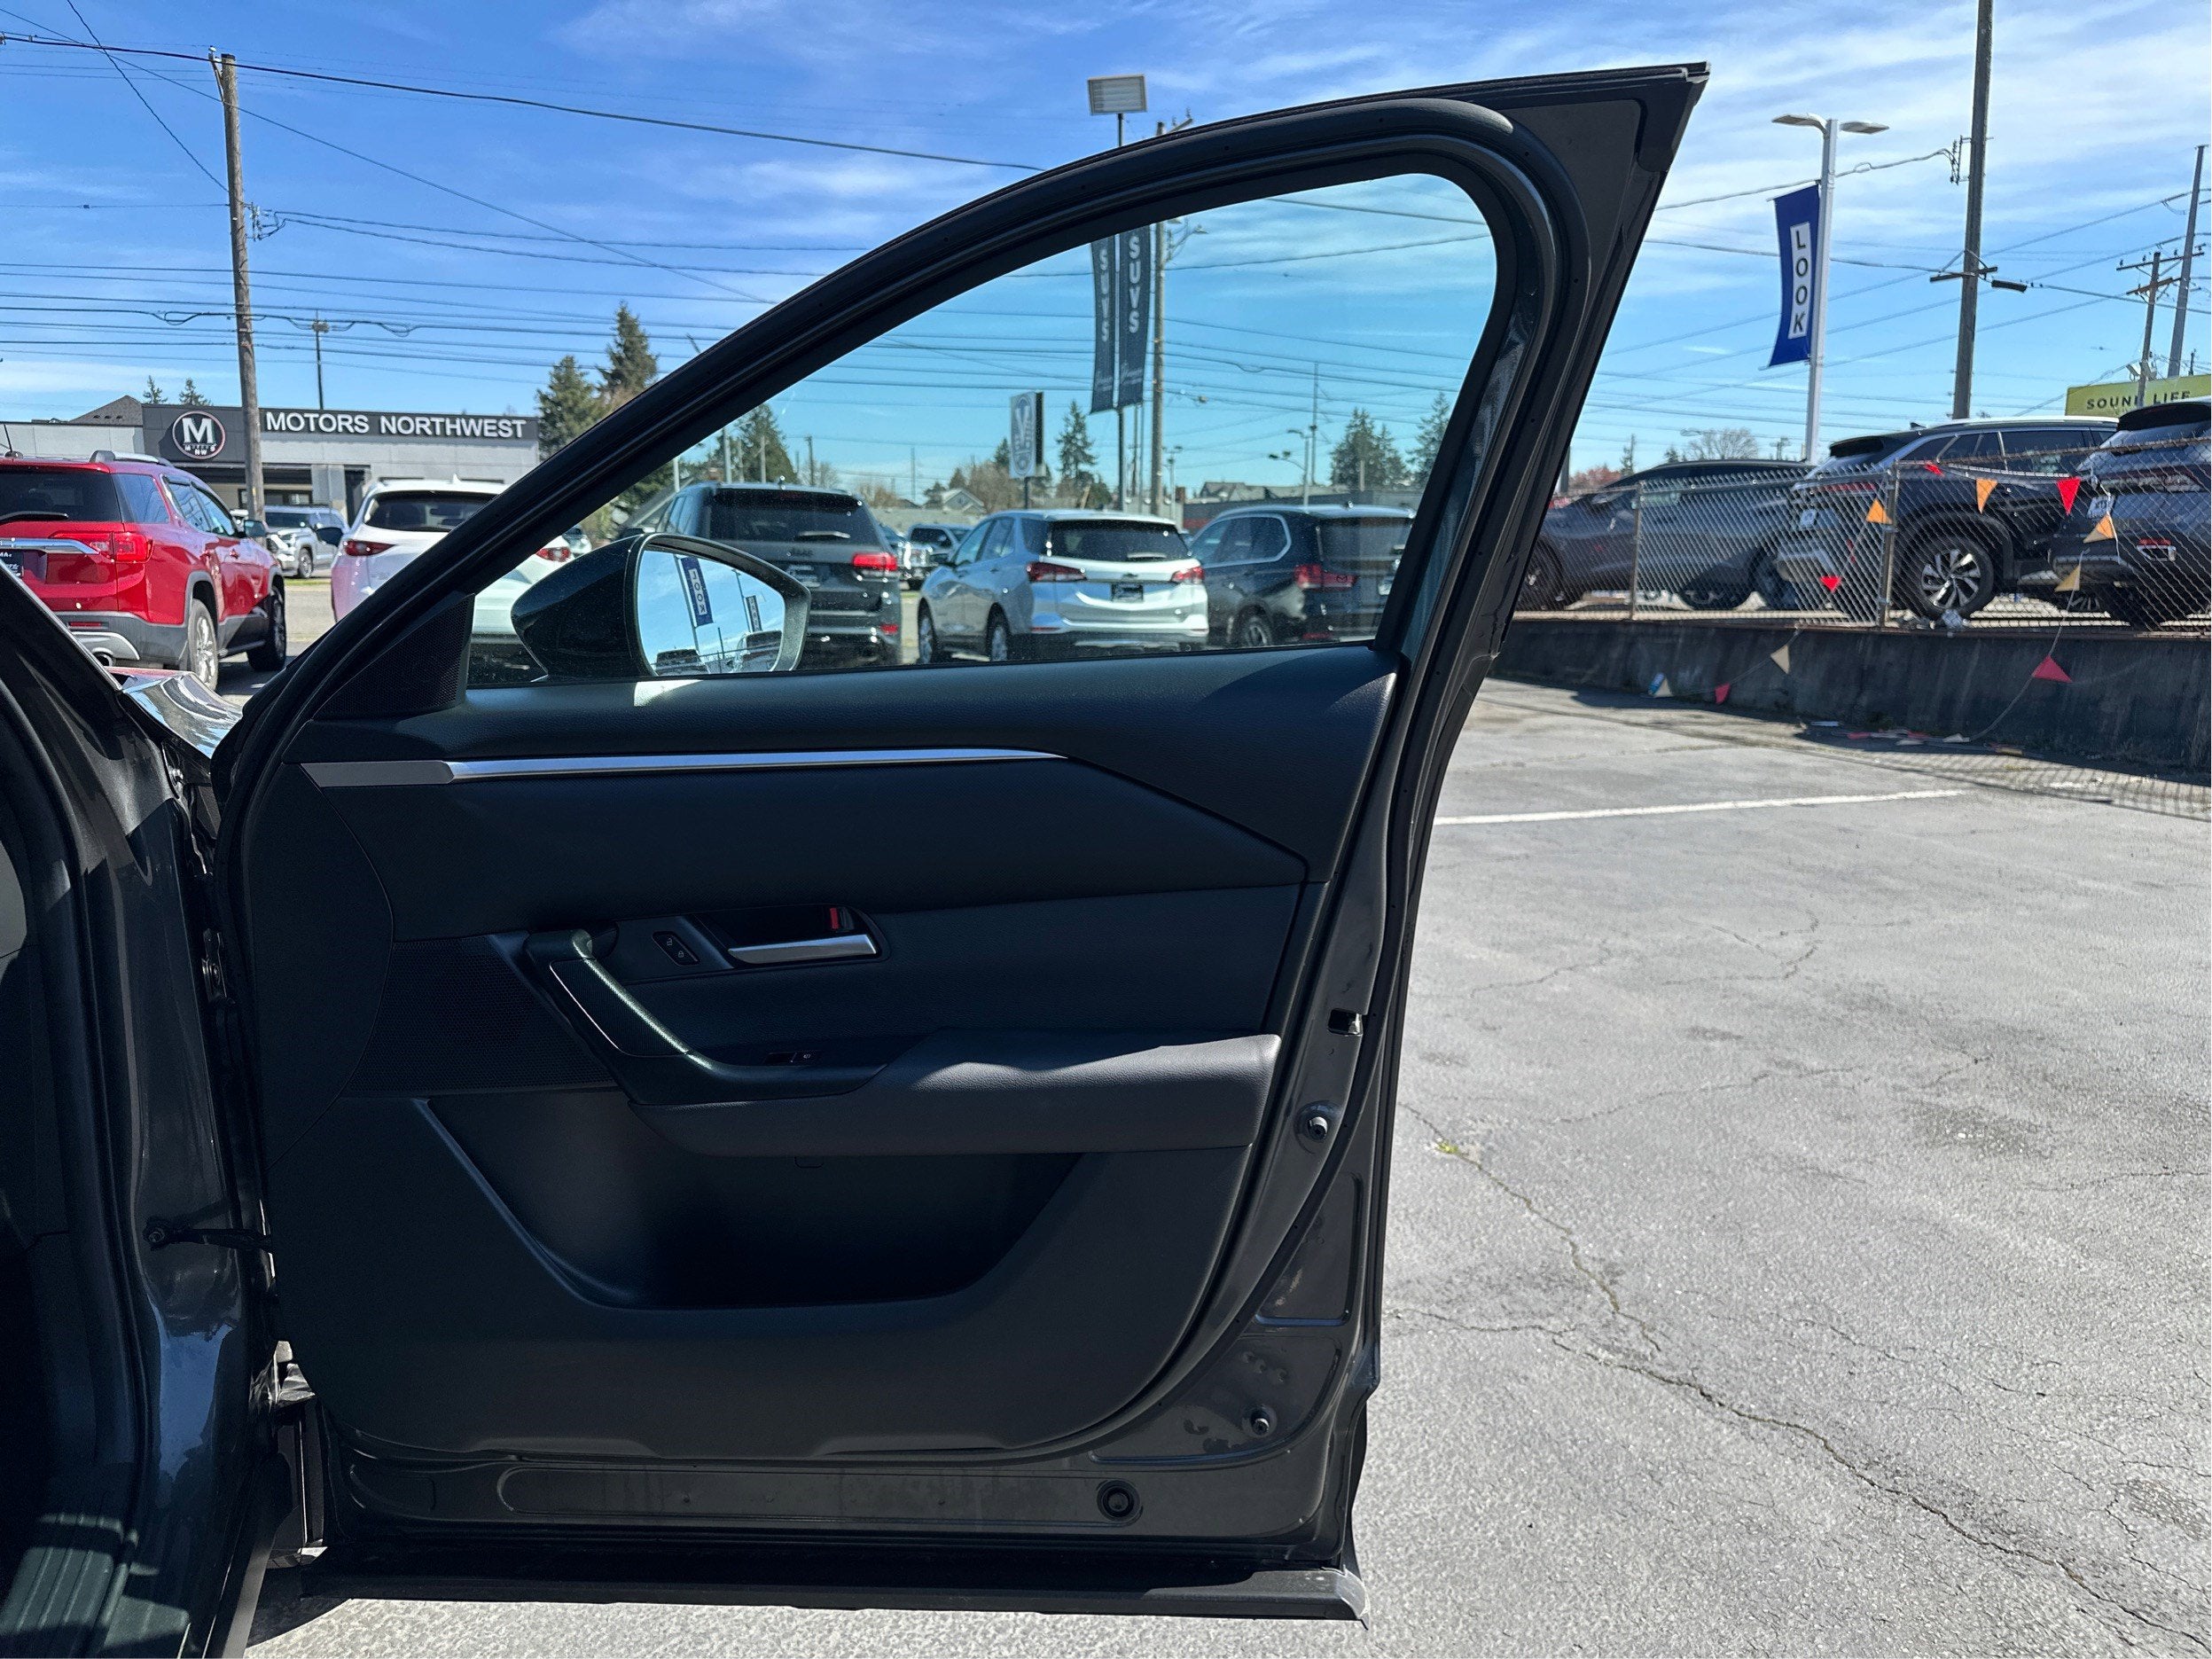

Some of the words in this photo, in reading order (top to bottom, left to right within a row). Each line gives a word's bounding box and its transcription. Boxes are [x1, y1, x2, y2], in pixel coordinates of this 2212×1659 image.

[1099, 249, 1110, 342] SUVS
[1129, 236, 1142, 333] SUVS
[1793, 231, 1809, 333] LOOK
[182, 418, 217, 443] M
[265, 411, 371, 434] MOTORS
[379, 415, 528, 439] NORTHWEST
